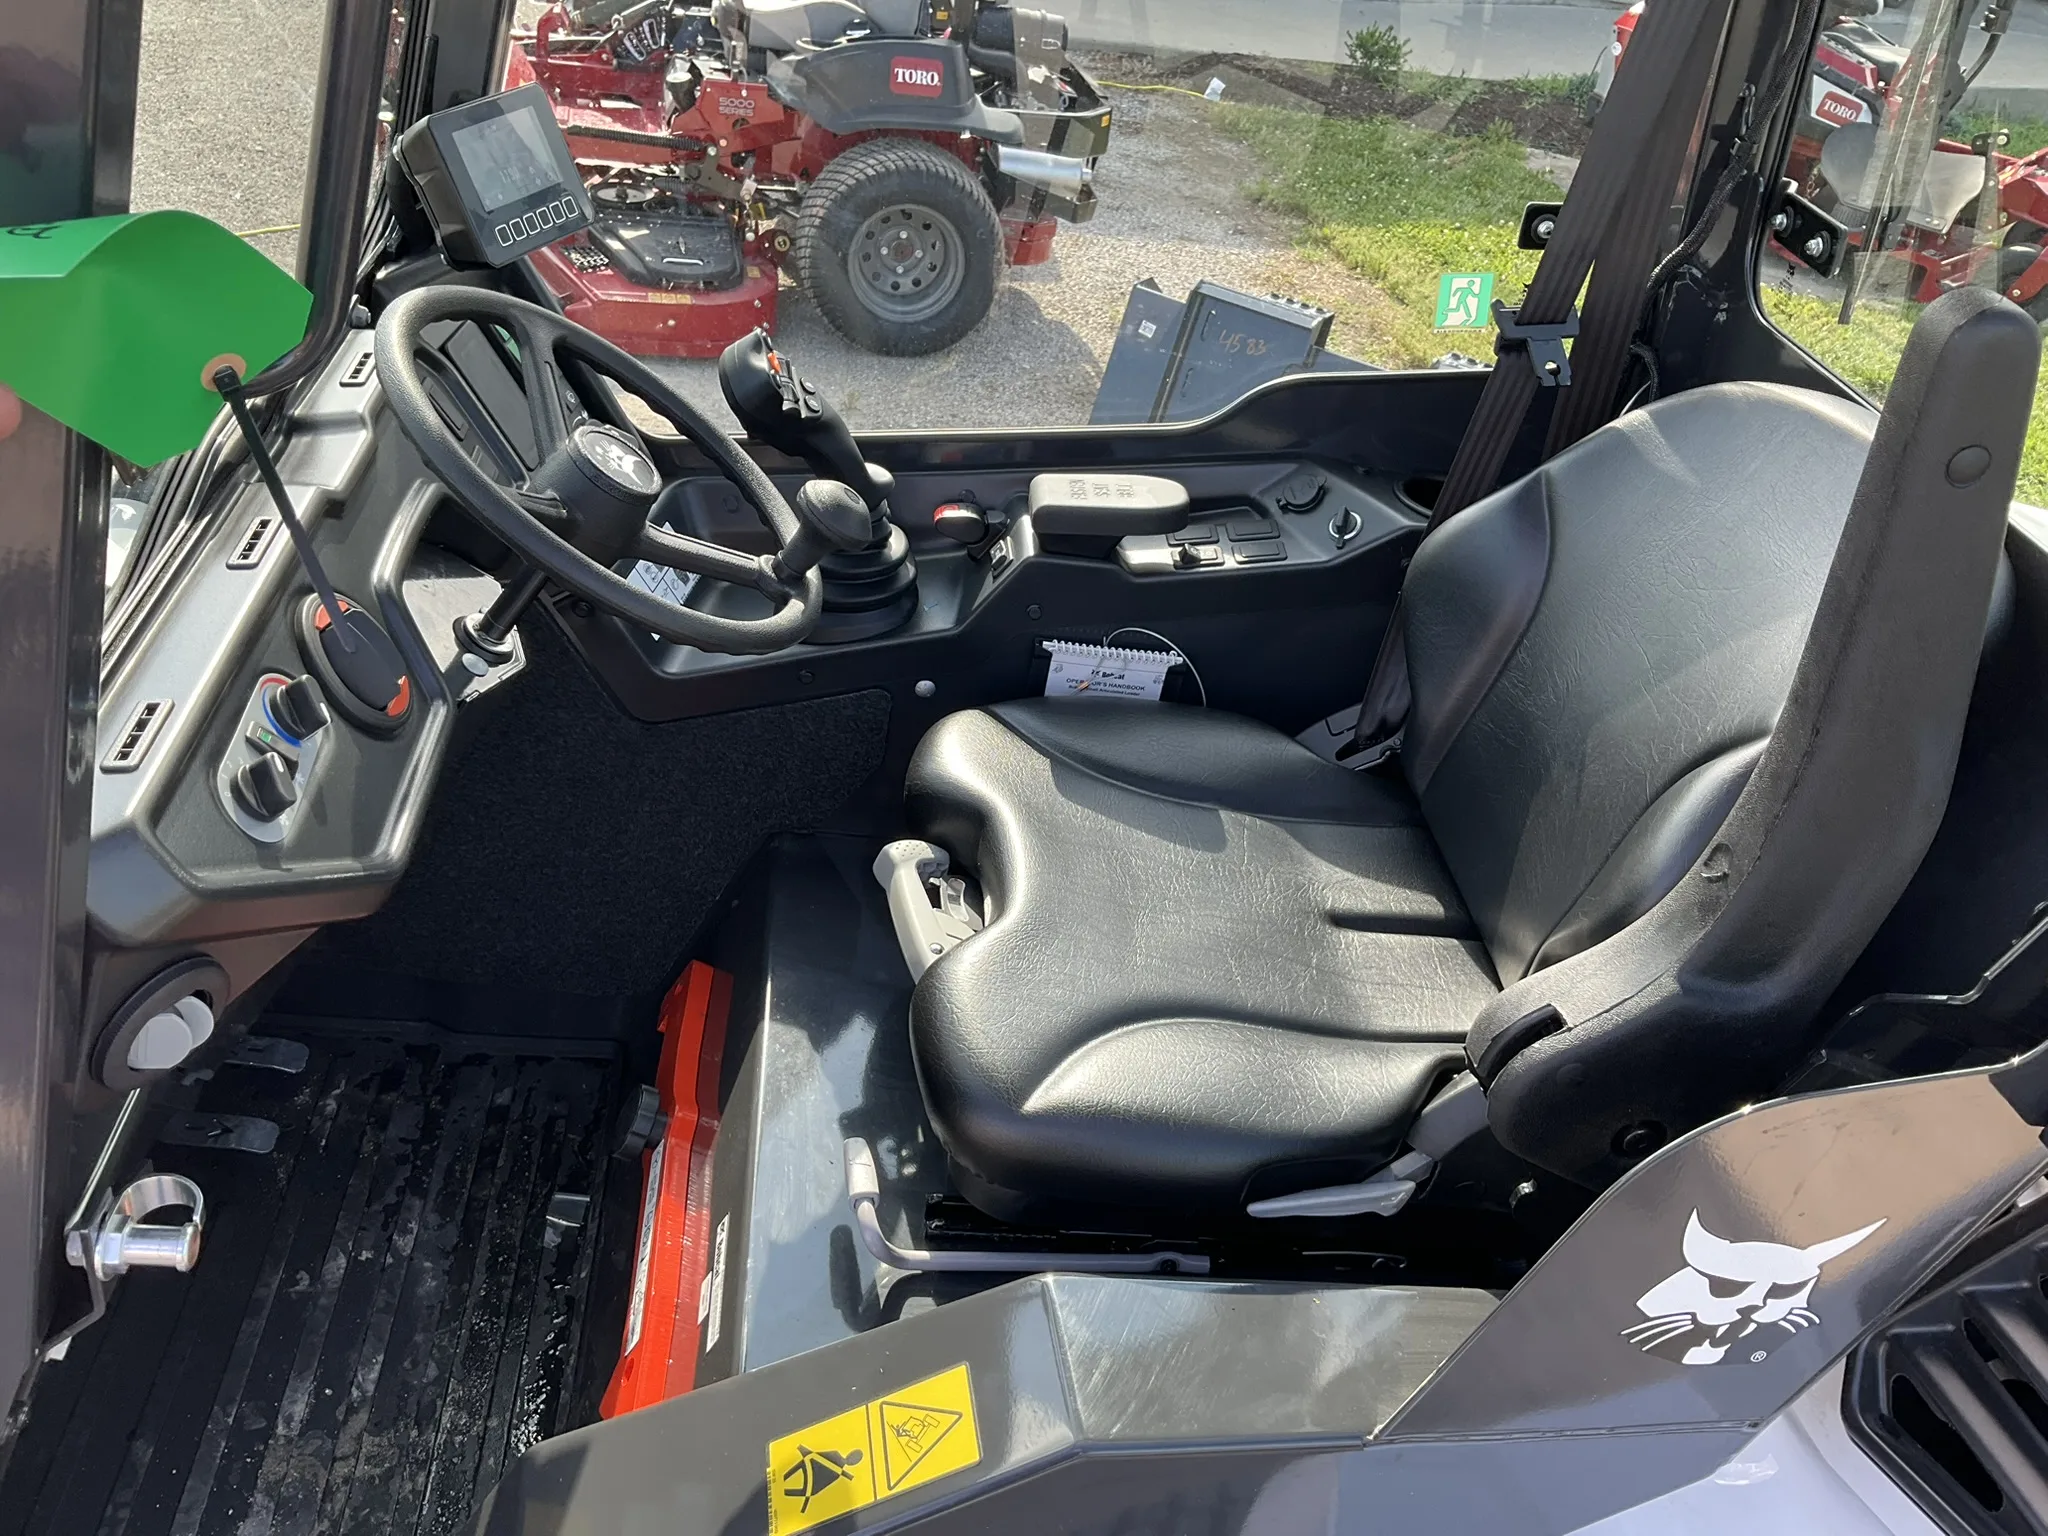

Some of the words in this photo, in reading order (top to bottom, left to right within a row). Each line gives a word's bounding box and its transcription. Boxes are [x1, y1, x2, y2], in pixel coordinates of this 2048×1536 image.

[894, 67, 940, 86] TORO
[719, 96, 755, 109] 5000
[719, 106, 754, 117] SERIES
[1823, 98, 1857, 121] TORO
[1108, 682, 1145, 691] HANDBOOK
